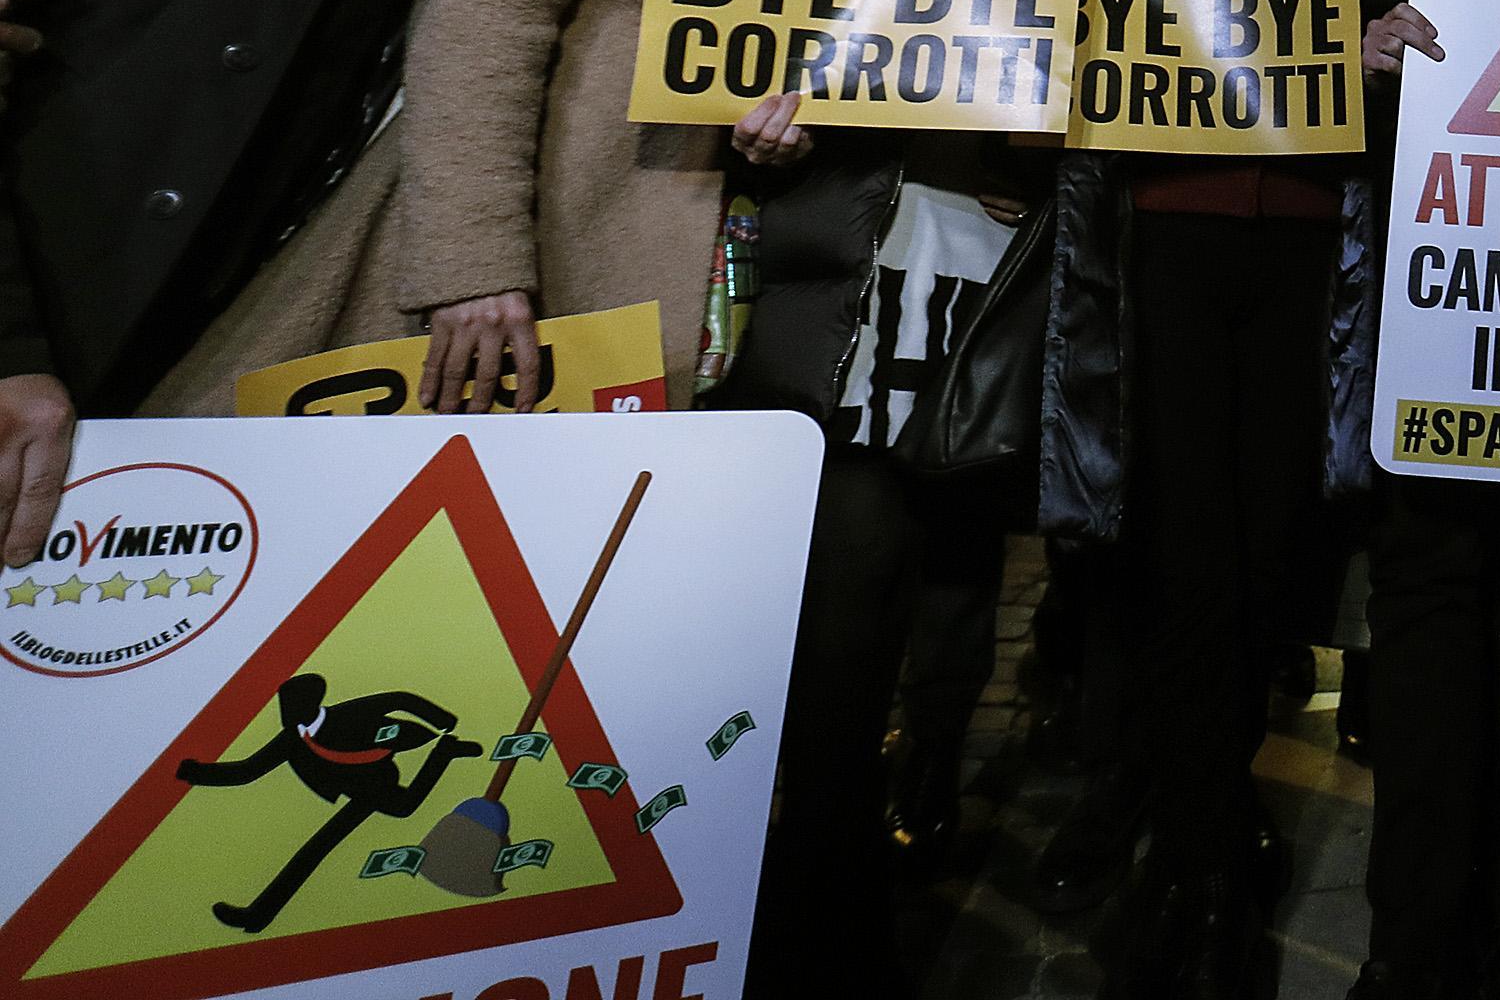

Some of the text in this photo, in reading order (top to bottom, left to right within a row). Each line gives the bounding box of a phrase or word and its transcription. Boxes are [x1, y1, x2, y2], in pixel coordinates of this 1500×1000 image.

[663, 16, 1054, 106] CORROTTI
[1069, 58, 1348, 130] ORROTTI
[9, 617, 193, 666] ILBLOGDELLESTELLE.IT
